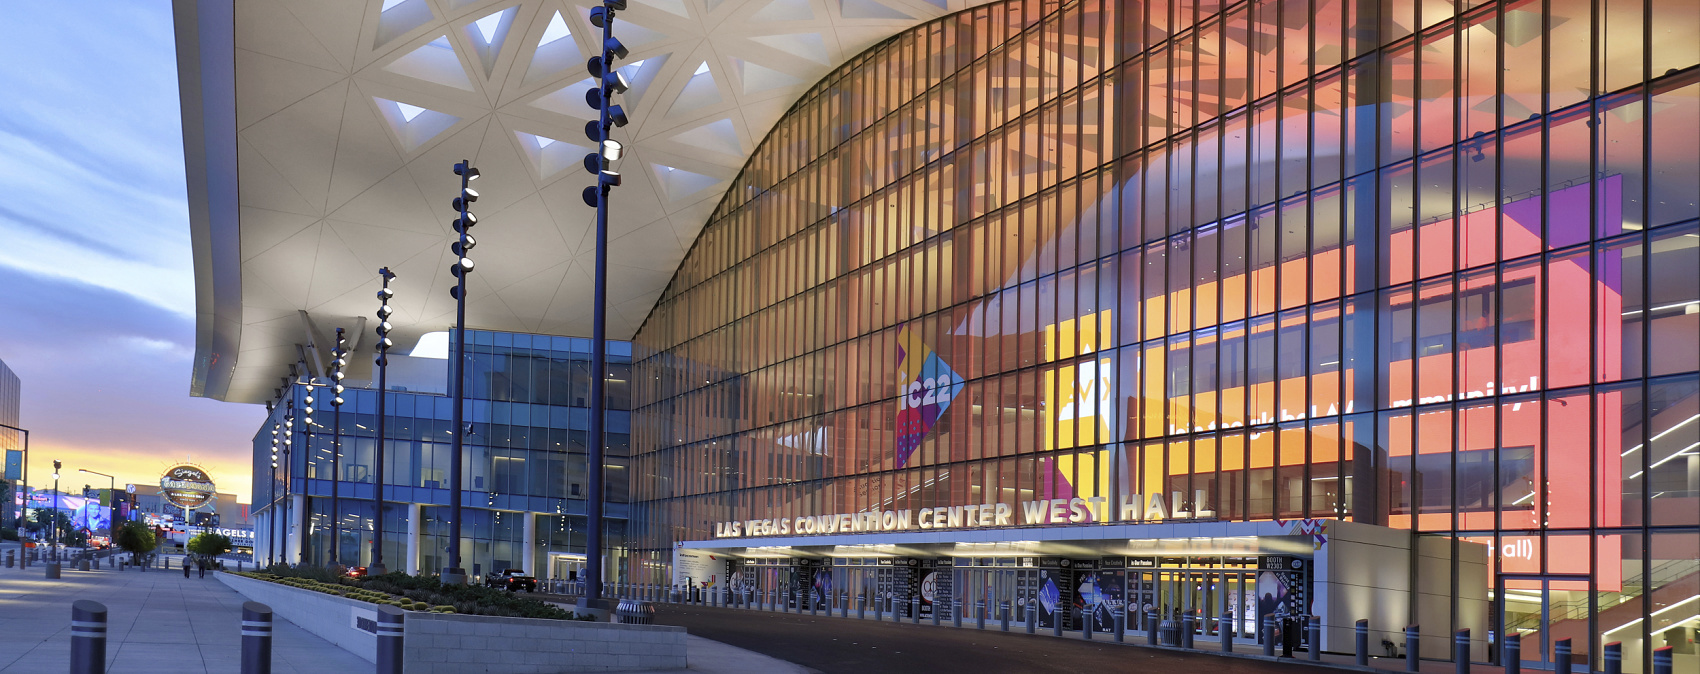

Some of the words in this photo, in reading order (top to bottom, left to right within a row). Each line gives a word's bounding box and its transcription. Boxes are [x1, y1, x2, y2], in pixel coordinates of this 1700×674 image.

[717, 521, 741, 538] LAS
[745, 517, 791, 537] VEGAS
[795, 509, 912, 535] CONVENTION
[918, 502, 1013, 530] CENTER
[1022, 496, 1106, 524] WEST
[1120, 489, 1216, 520] HALL
